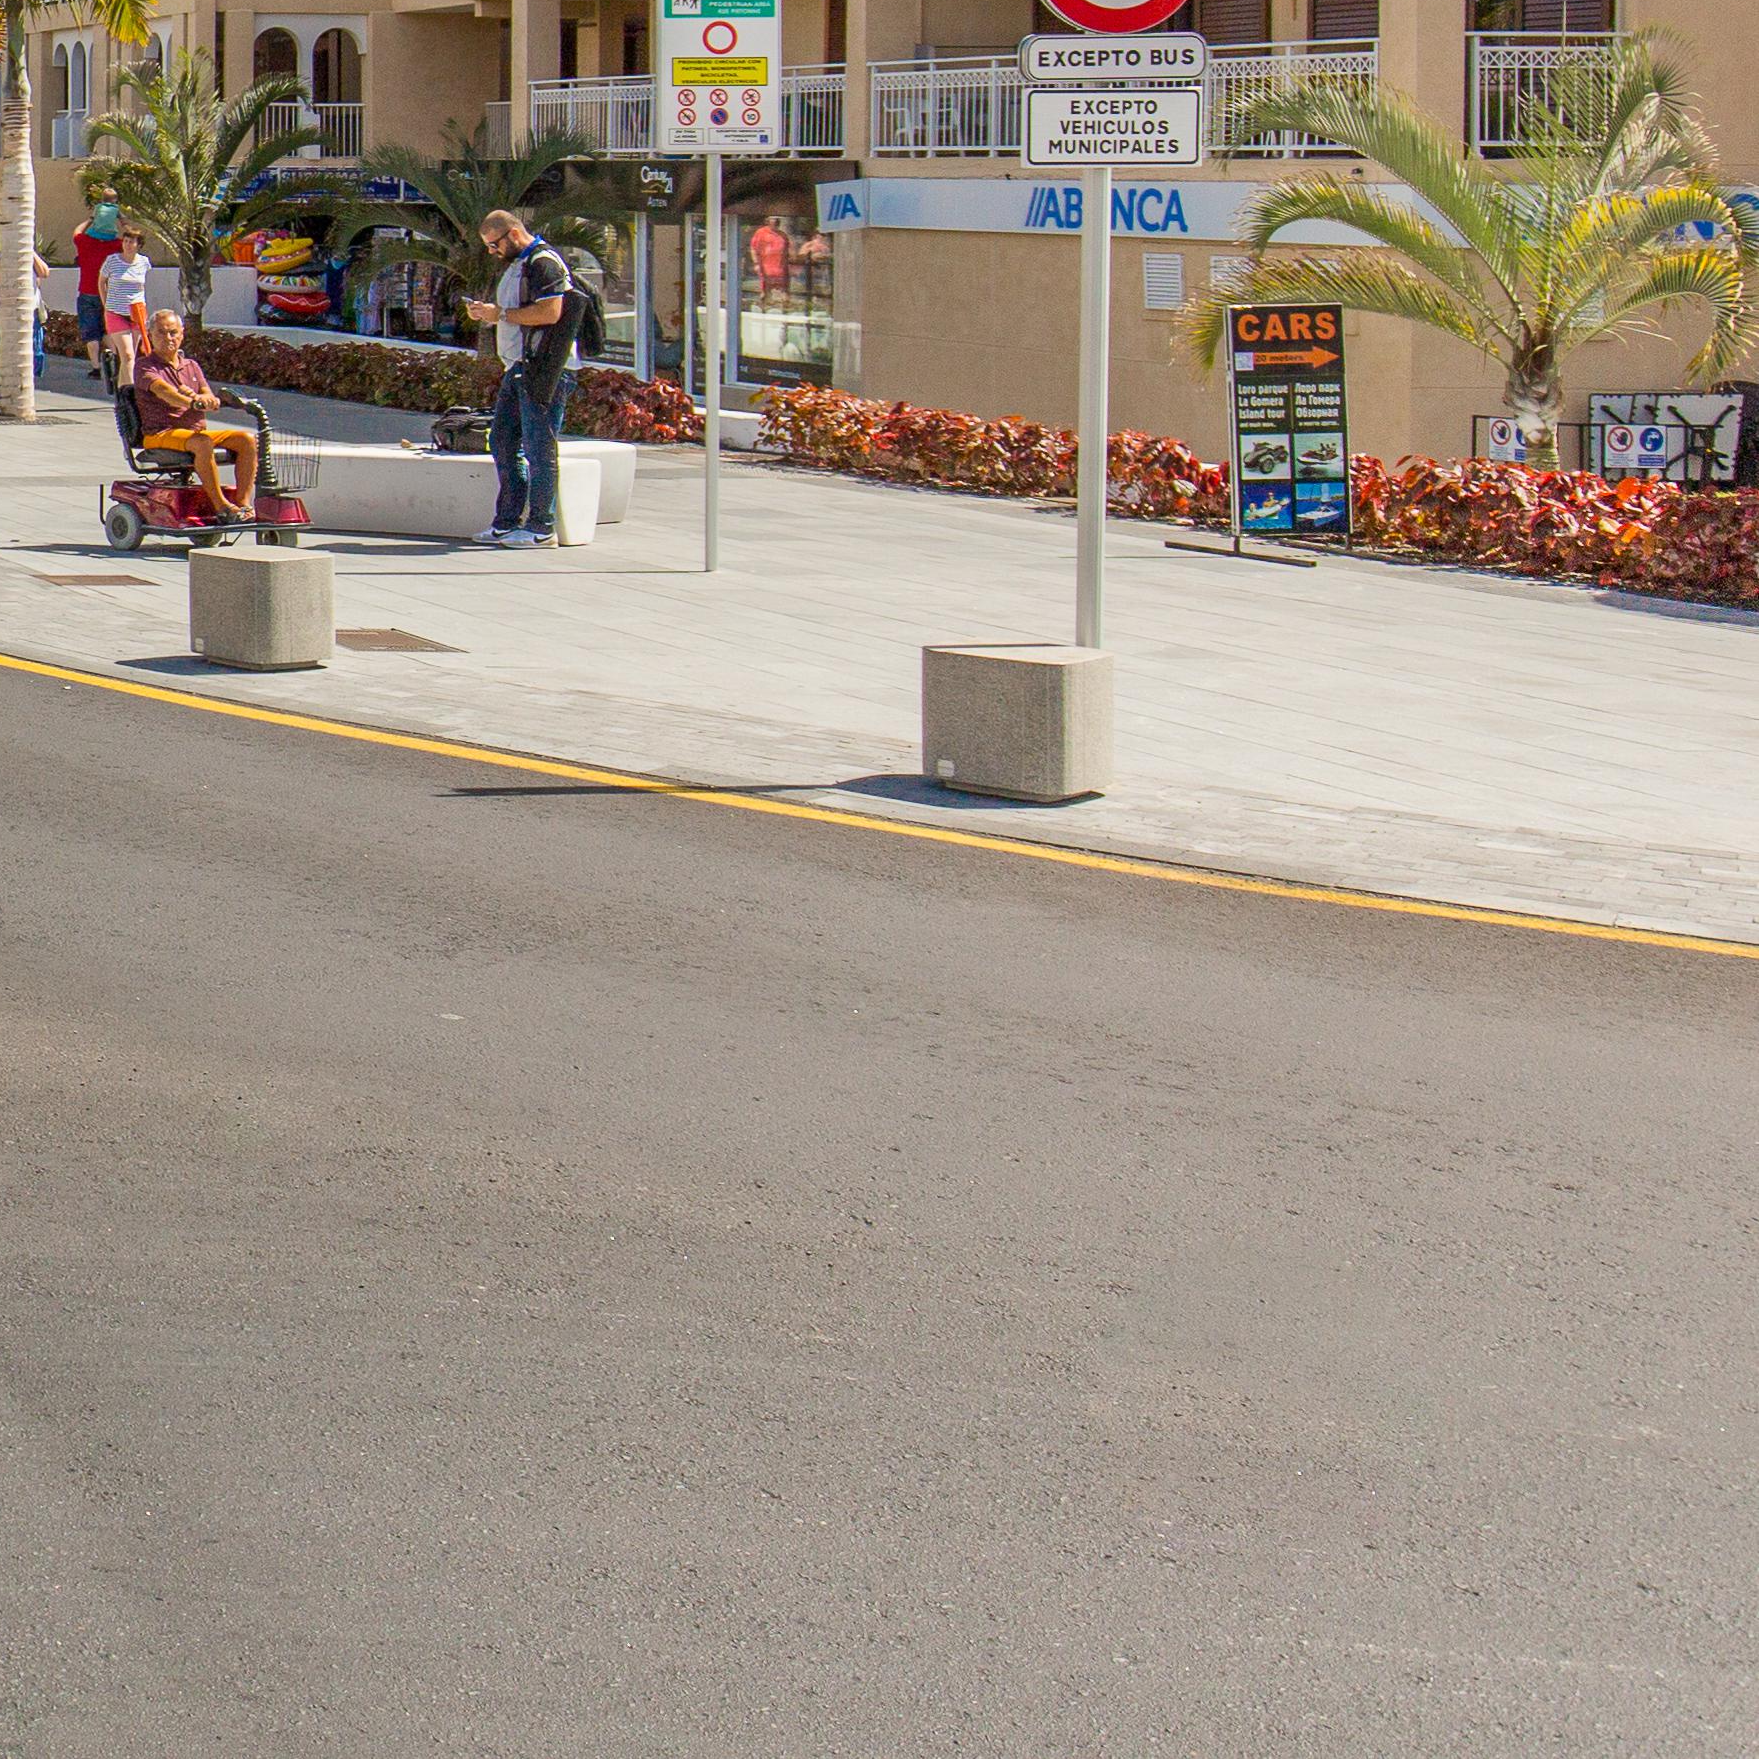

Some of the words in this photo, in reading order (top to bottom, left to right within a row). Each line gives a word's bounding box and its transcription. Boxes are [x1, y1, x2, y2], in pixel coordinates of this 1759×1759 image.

[1037, 50, 1142, 68] EXCEPTO
[1150, 48, 1195, 67] BUS
[1070, 99, 1158, 115] EXCEPTO
[1059, 120, 1170, 136] VEHICULOS
[1048, 139, 1180, 155] MUNICIPALES
[1038, 187, 1189, 232] ABNCA
[1237, 312, 1337, 342] CARS
[1255, 354, 1267, 362] 20
[1238, 384, 1256, 395] Loro
[1258, 384, 1289, 396] parque
[1238, 397, 1249, 407] La
[1250, 396, 1284, 407] Gomera
[1238, 408, 1265, 419] Island
[1267, 408, 1286, 419] tour
